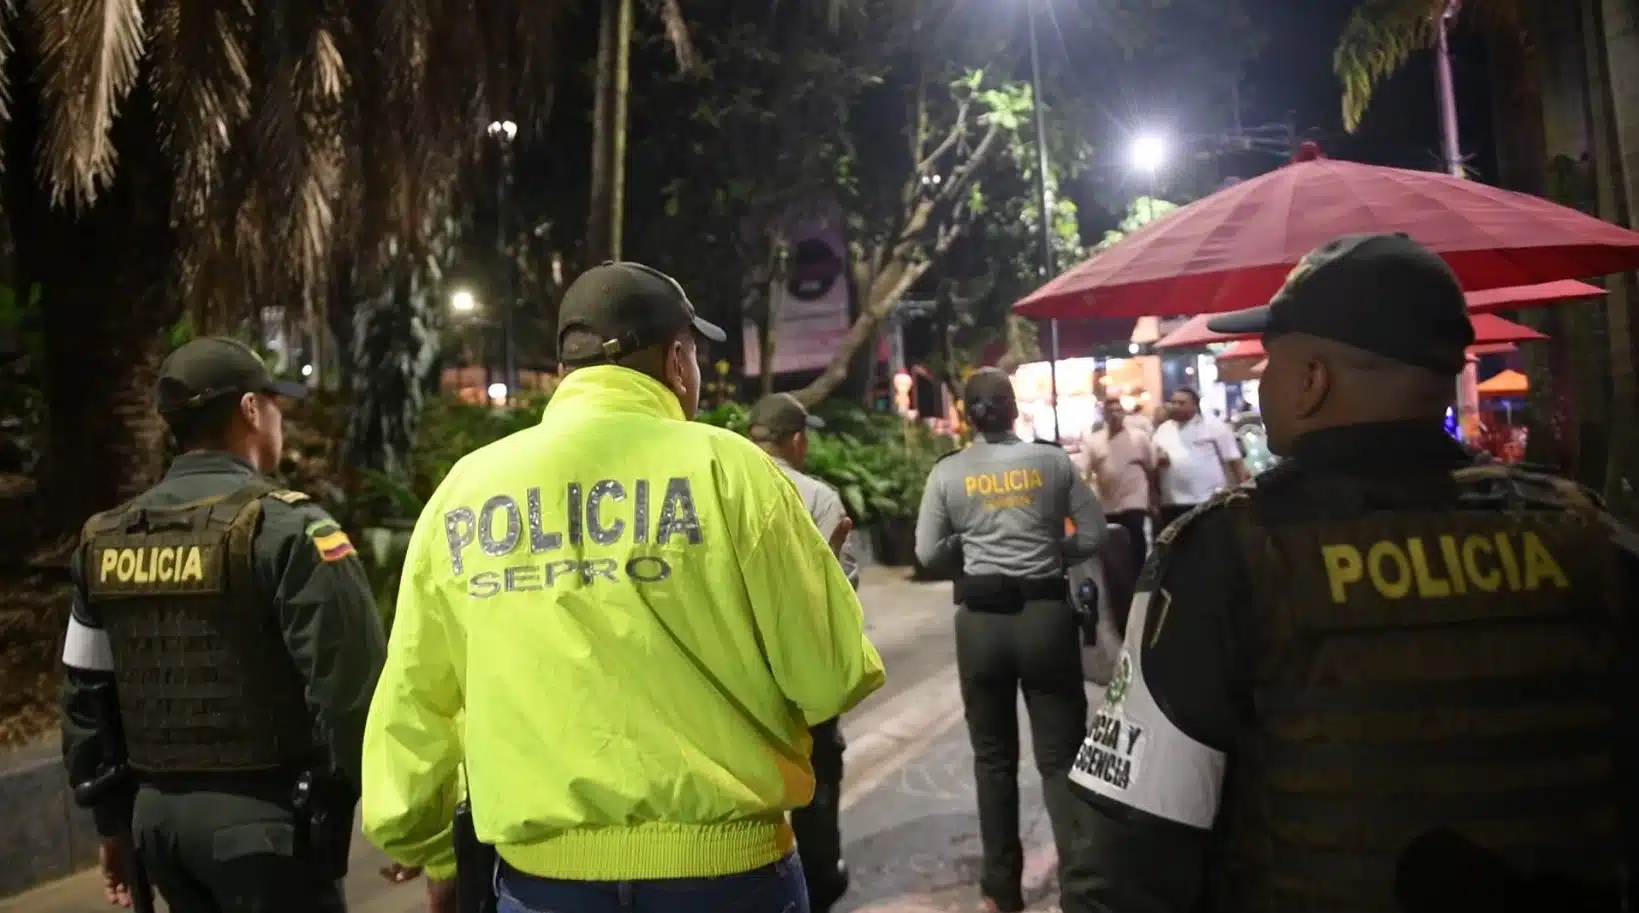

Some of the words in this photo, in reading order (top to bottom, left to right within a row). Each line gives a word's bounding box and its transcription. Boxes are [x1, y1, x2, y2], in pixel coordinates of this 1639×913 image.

[964, 468, 1043, 497] POLICIA
[444, 477, 705, 576] POLICIA
[100, 546, 203, 583] POLICIA
[468, 555, 672, 599] SEPRO
[1321, 531, 1571, 603] POLICIA
[1127, 724, 1142, 755] Y
